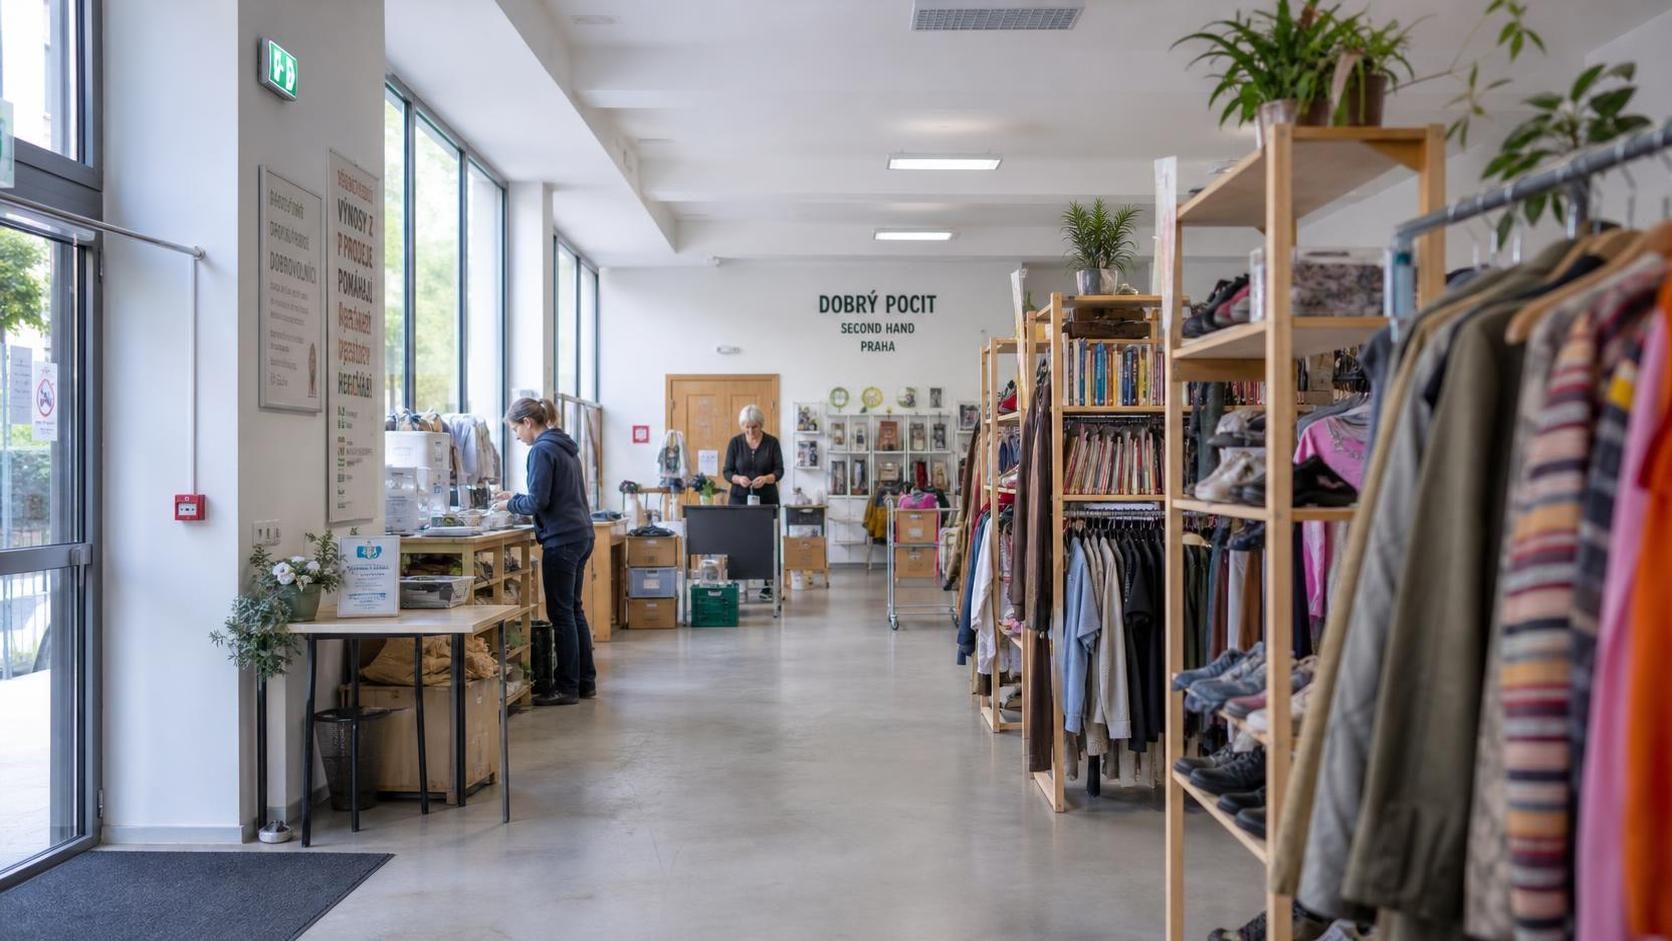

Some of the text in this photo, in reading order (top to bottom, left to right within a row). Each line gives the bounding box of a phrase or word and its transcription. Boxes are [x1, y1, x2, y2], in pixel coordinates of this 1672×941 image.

[337, 197, 367, 234] VÝNOSY
[819, 289, 937, 314] DOBRÝ POCIT
[841, 322, 915, 334] SECOND HAND
[860, 340, 896, 352] PRAHA
